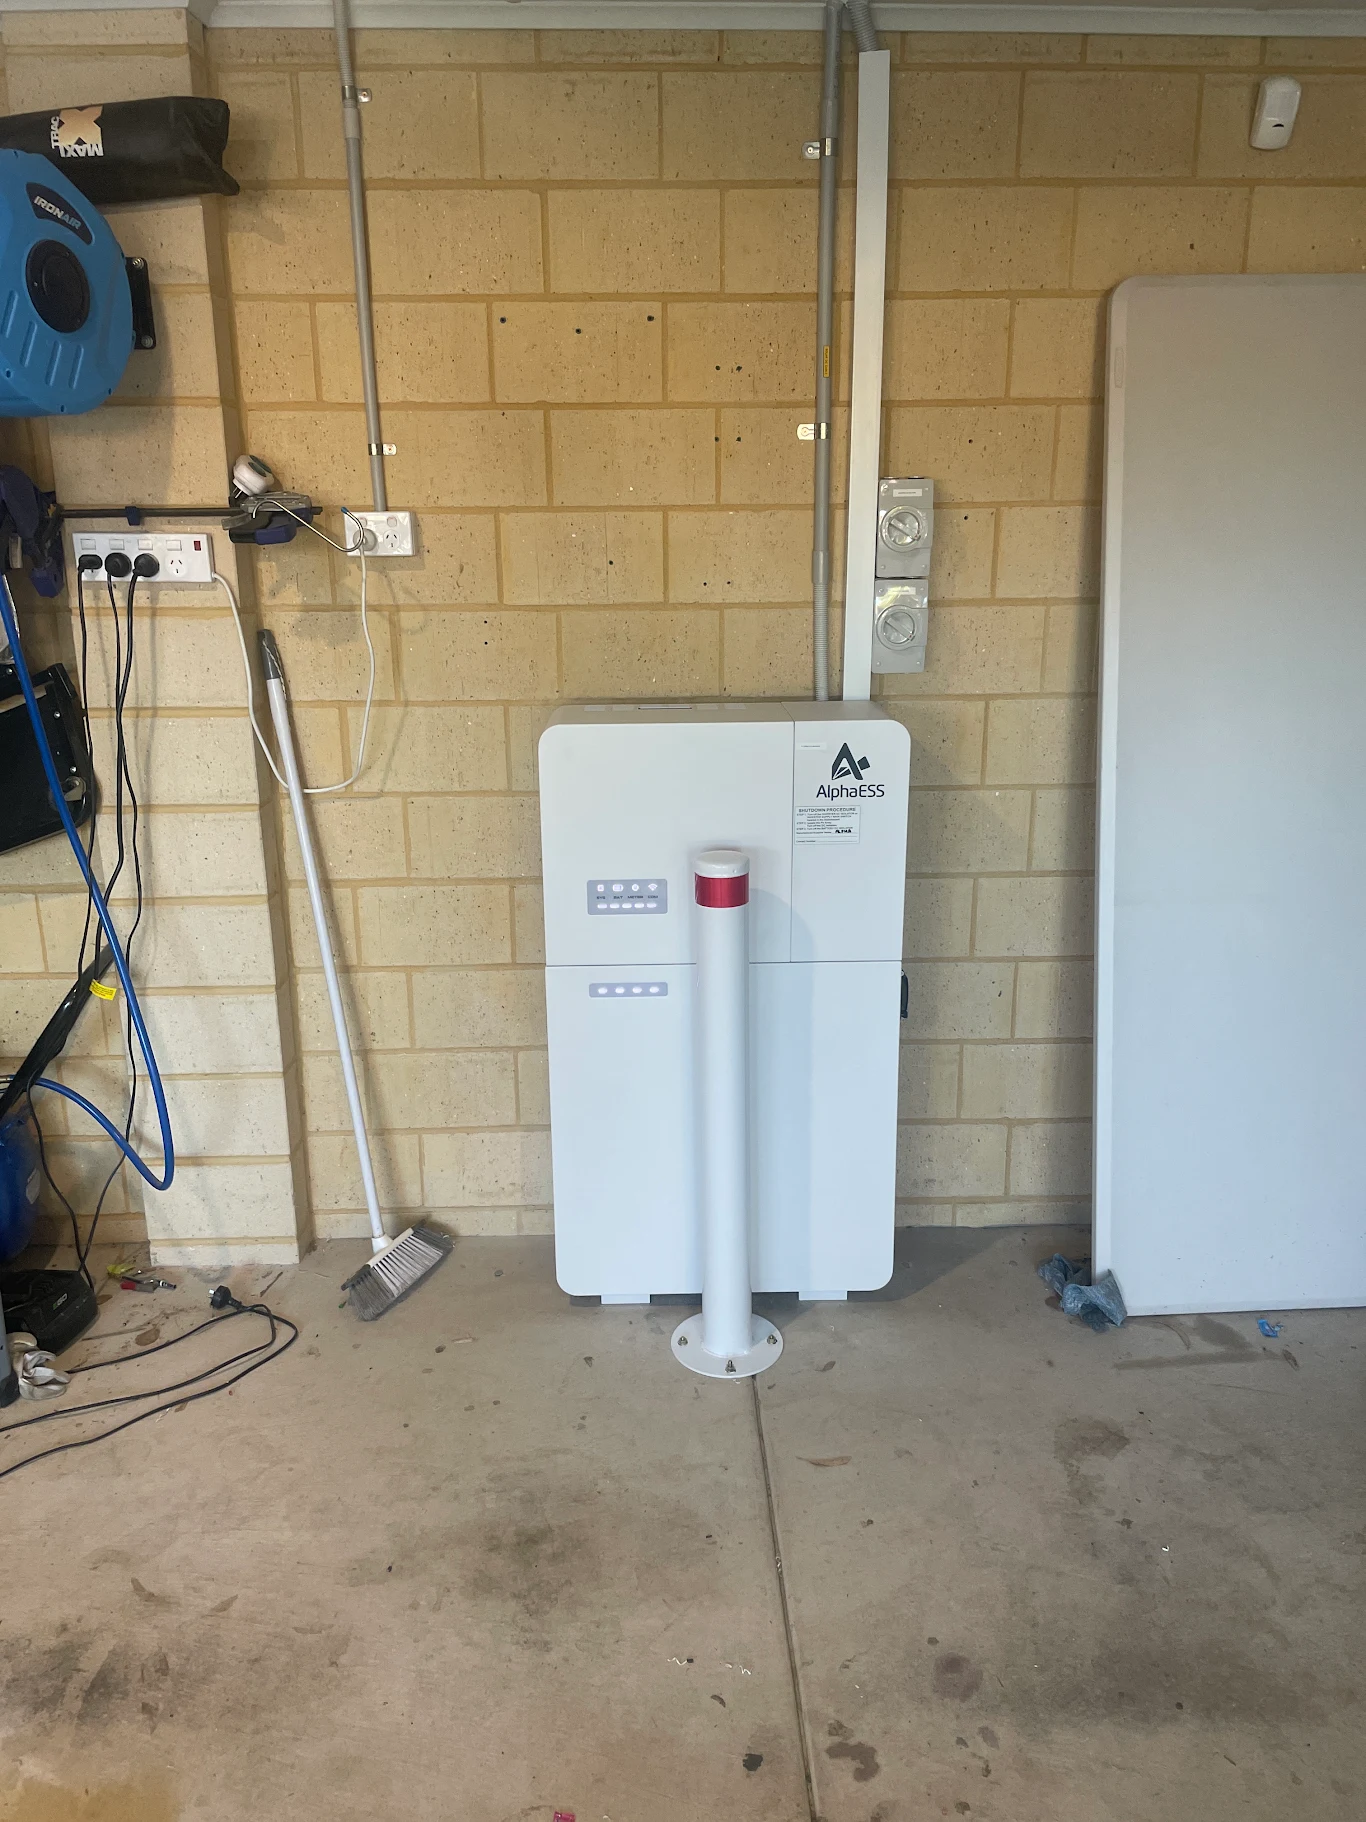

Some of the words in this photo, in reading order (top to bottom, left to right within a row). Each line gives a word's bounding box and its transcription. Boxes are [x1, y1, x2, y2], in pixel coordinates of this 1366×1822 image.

[50, 116, 60, 150] TRAC
[58, 143, 104, 158] MAXI
[33, 195, 82, 231] IRONAIR
[816, 784, 885, 801] AlphaESS
